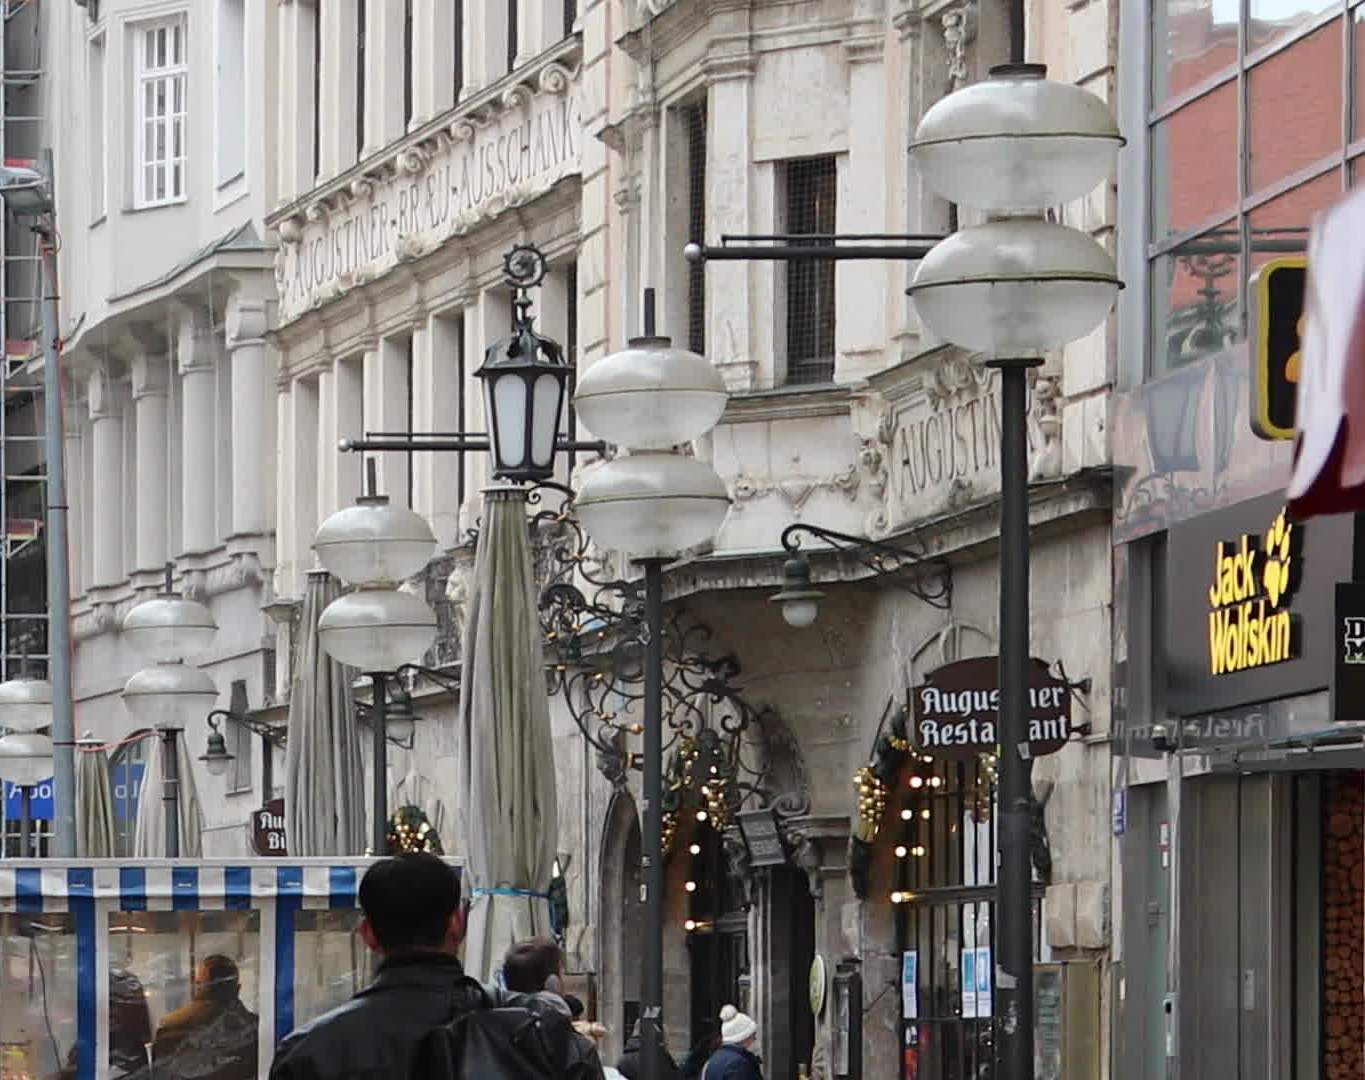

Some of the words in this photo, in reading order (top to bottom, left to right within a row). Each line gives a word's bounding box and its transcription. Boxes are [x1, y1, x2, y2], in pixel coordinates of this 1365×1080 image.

[1209, 534, 1256, 608] Jack
[1209, 599, 1292, 676] Wolfskin
[920, 686, 1065, 717] Auguser
[919, 715, 1070, 747] Restaant
